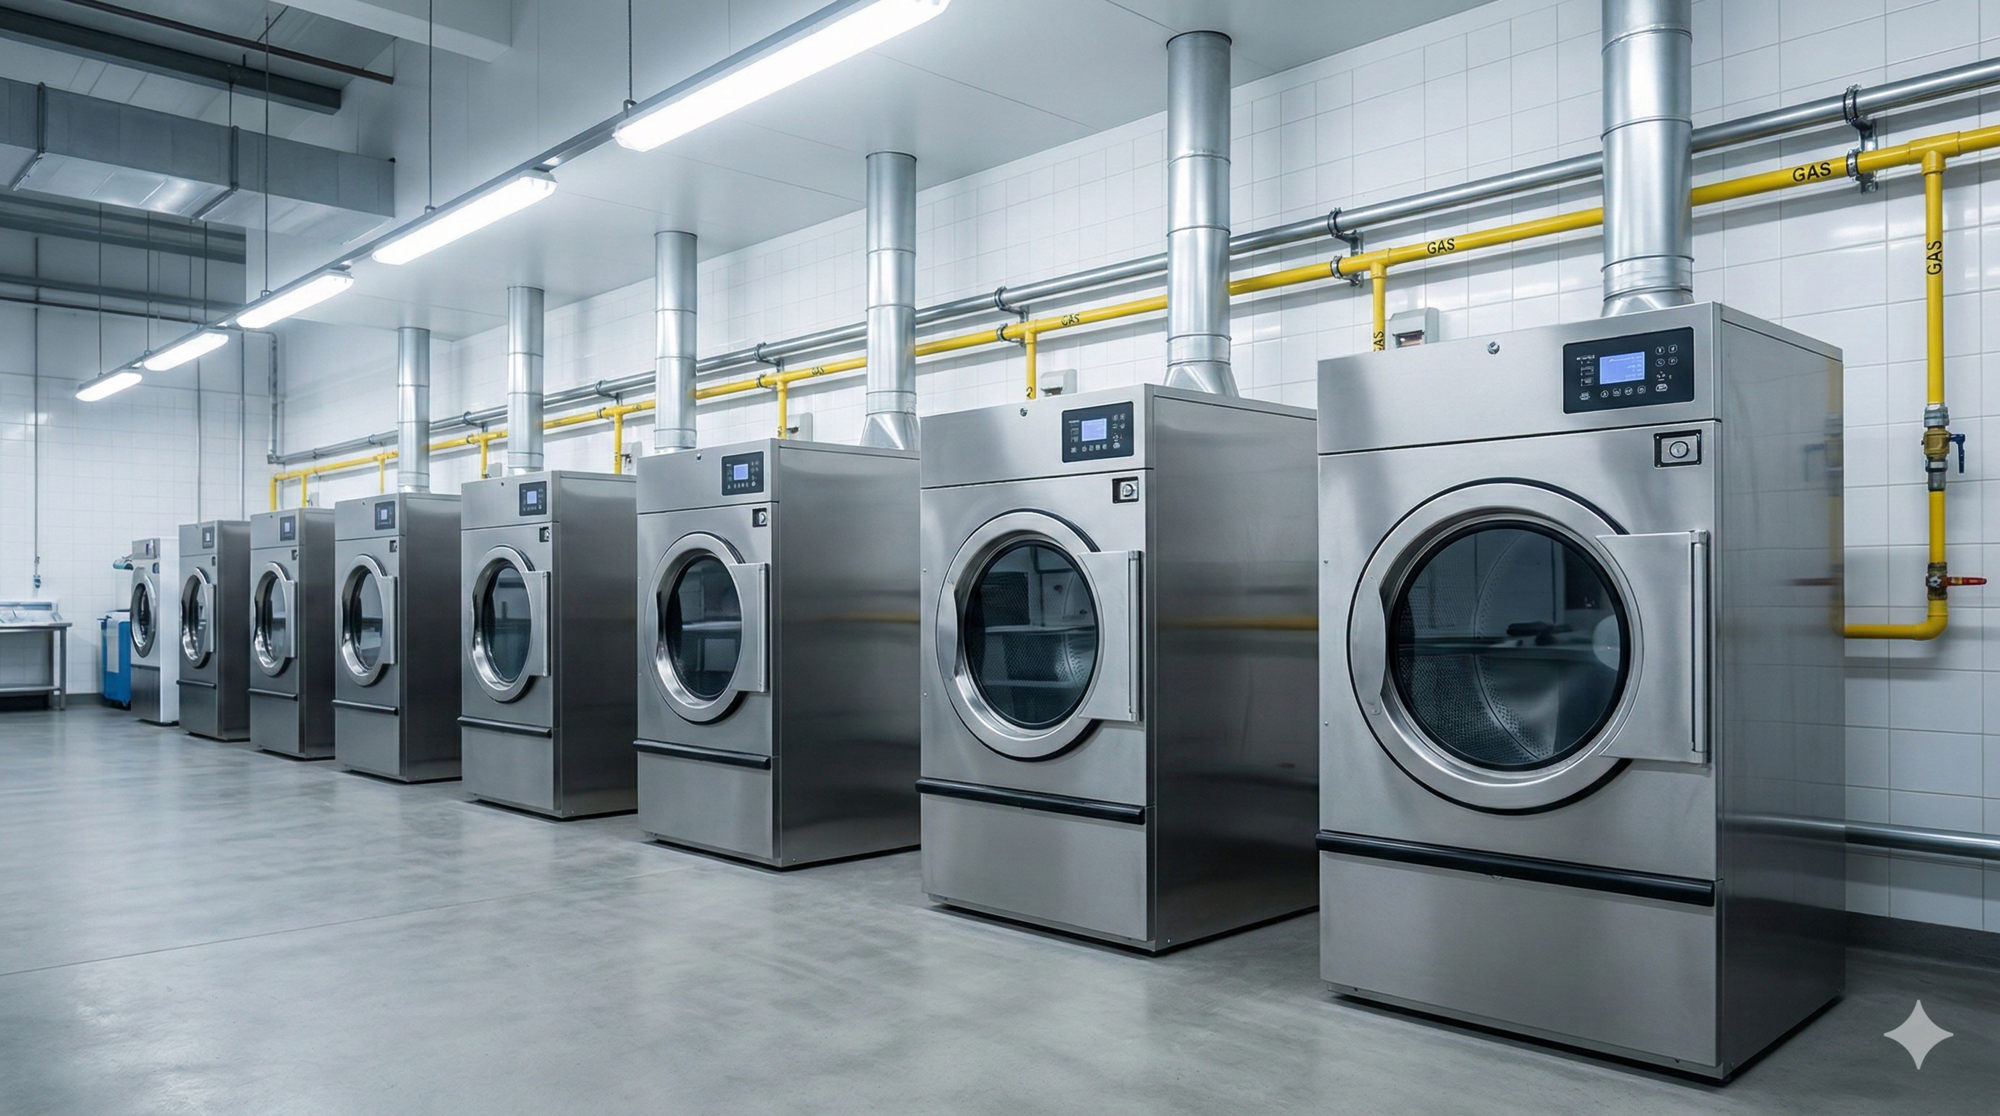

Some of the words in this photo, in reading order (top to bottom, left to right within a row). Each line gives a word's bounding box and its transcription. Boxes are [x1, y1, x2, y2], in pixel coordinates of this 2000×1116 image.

[1792, 162, 1831, 182] GAS
[1427, 238, 1455, 254] GAS
[1926, 240, 1942, 275] GAS
